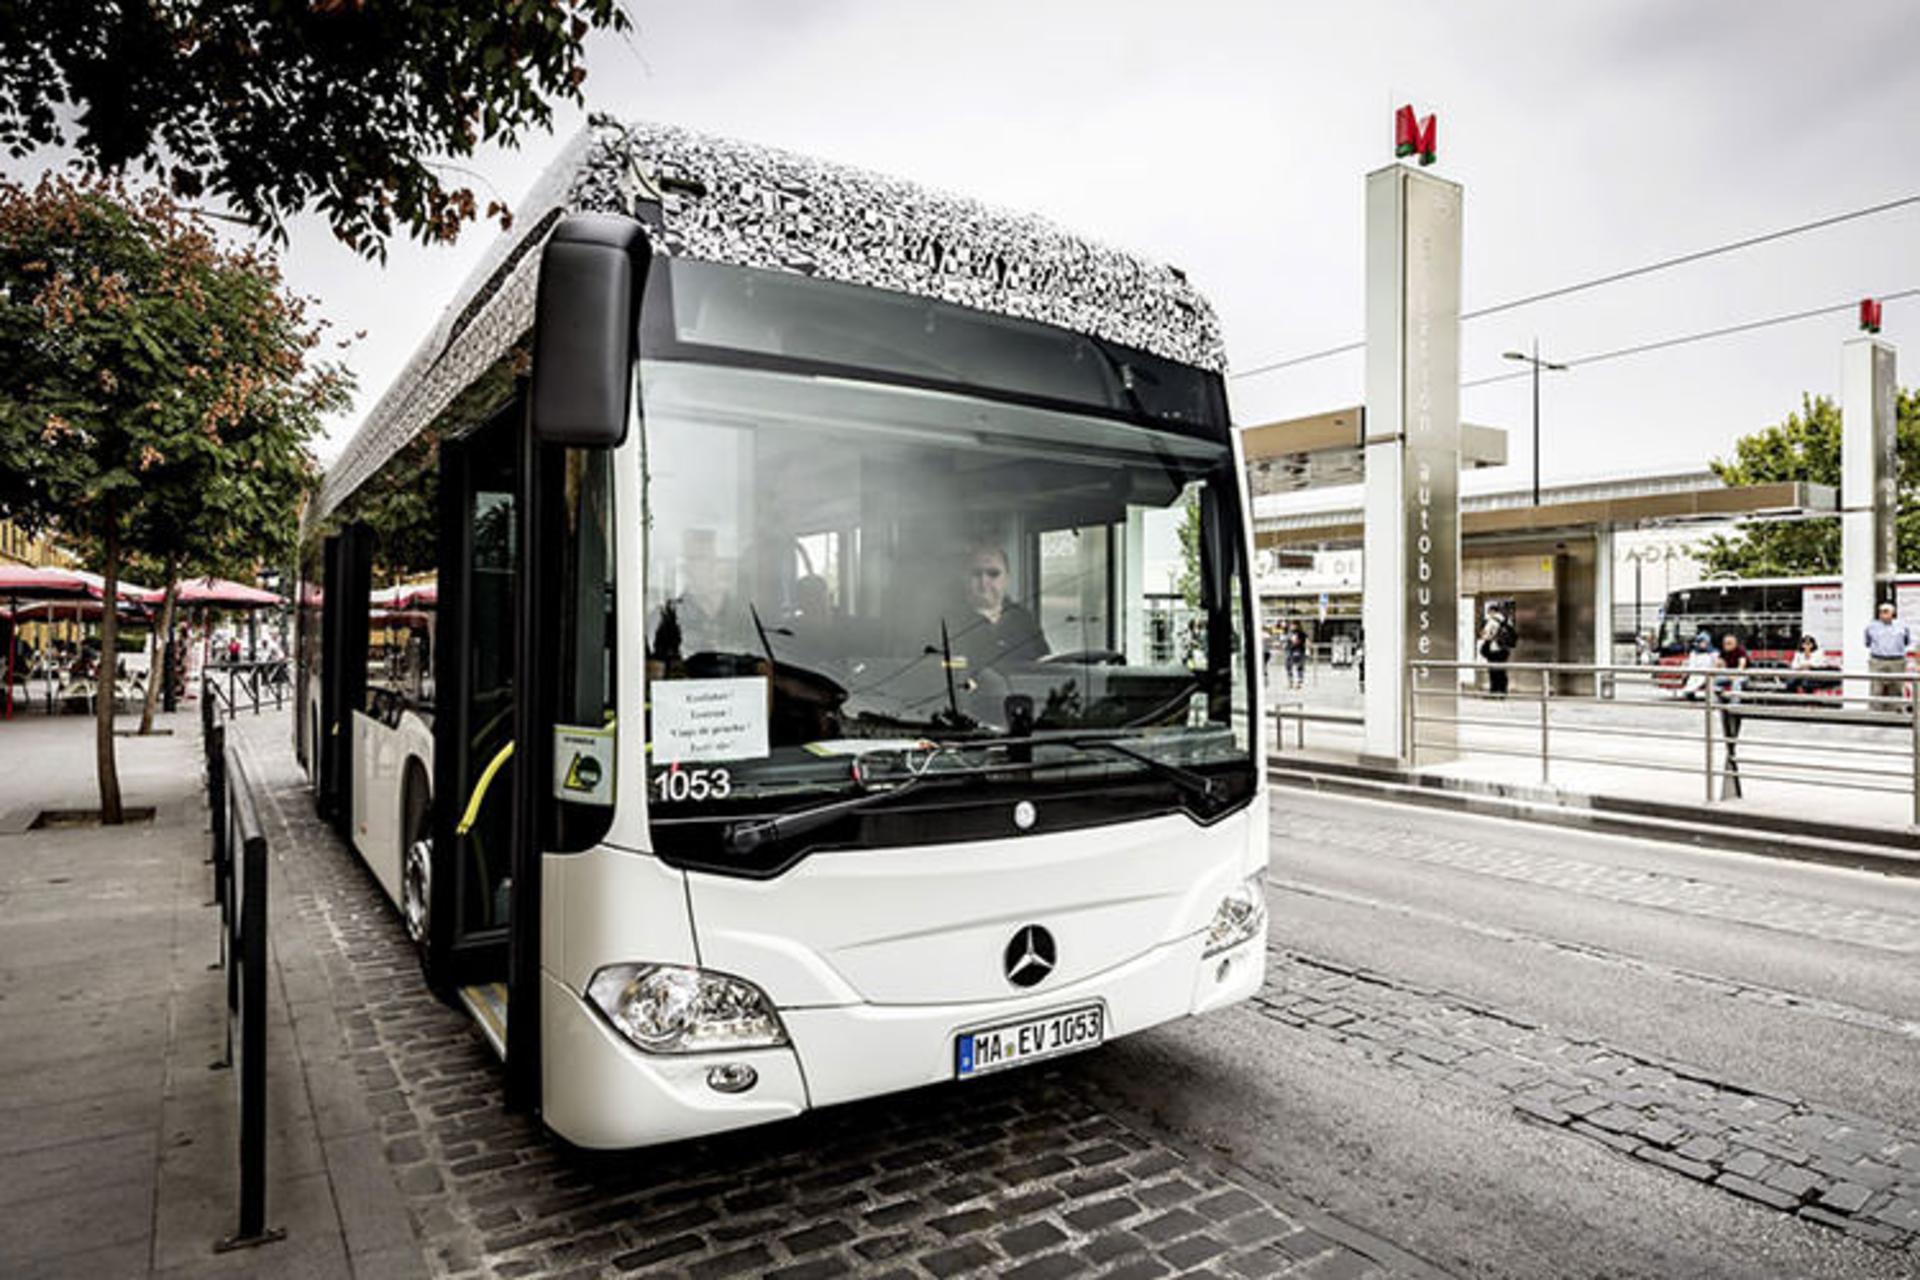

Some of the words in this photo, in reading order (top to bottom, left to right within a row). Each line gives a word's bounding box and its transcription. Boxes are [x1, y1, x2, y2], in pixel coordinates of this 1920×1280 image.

[1417, 462, 1432, 678] autobuses
[654, 769, 731, 801] 1053
[975, 1034, 1001, 1065] MA
[1018, 1023, 1046, 1055] EV
[1050, 1011, 1099, 1048] 1053
